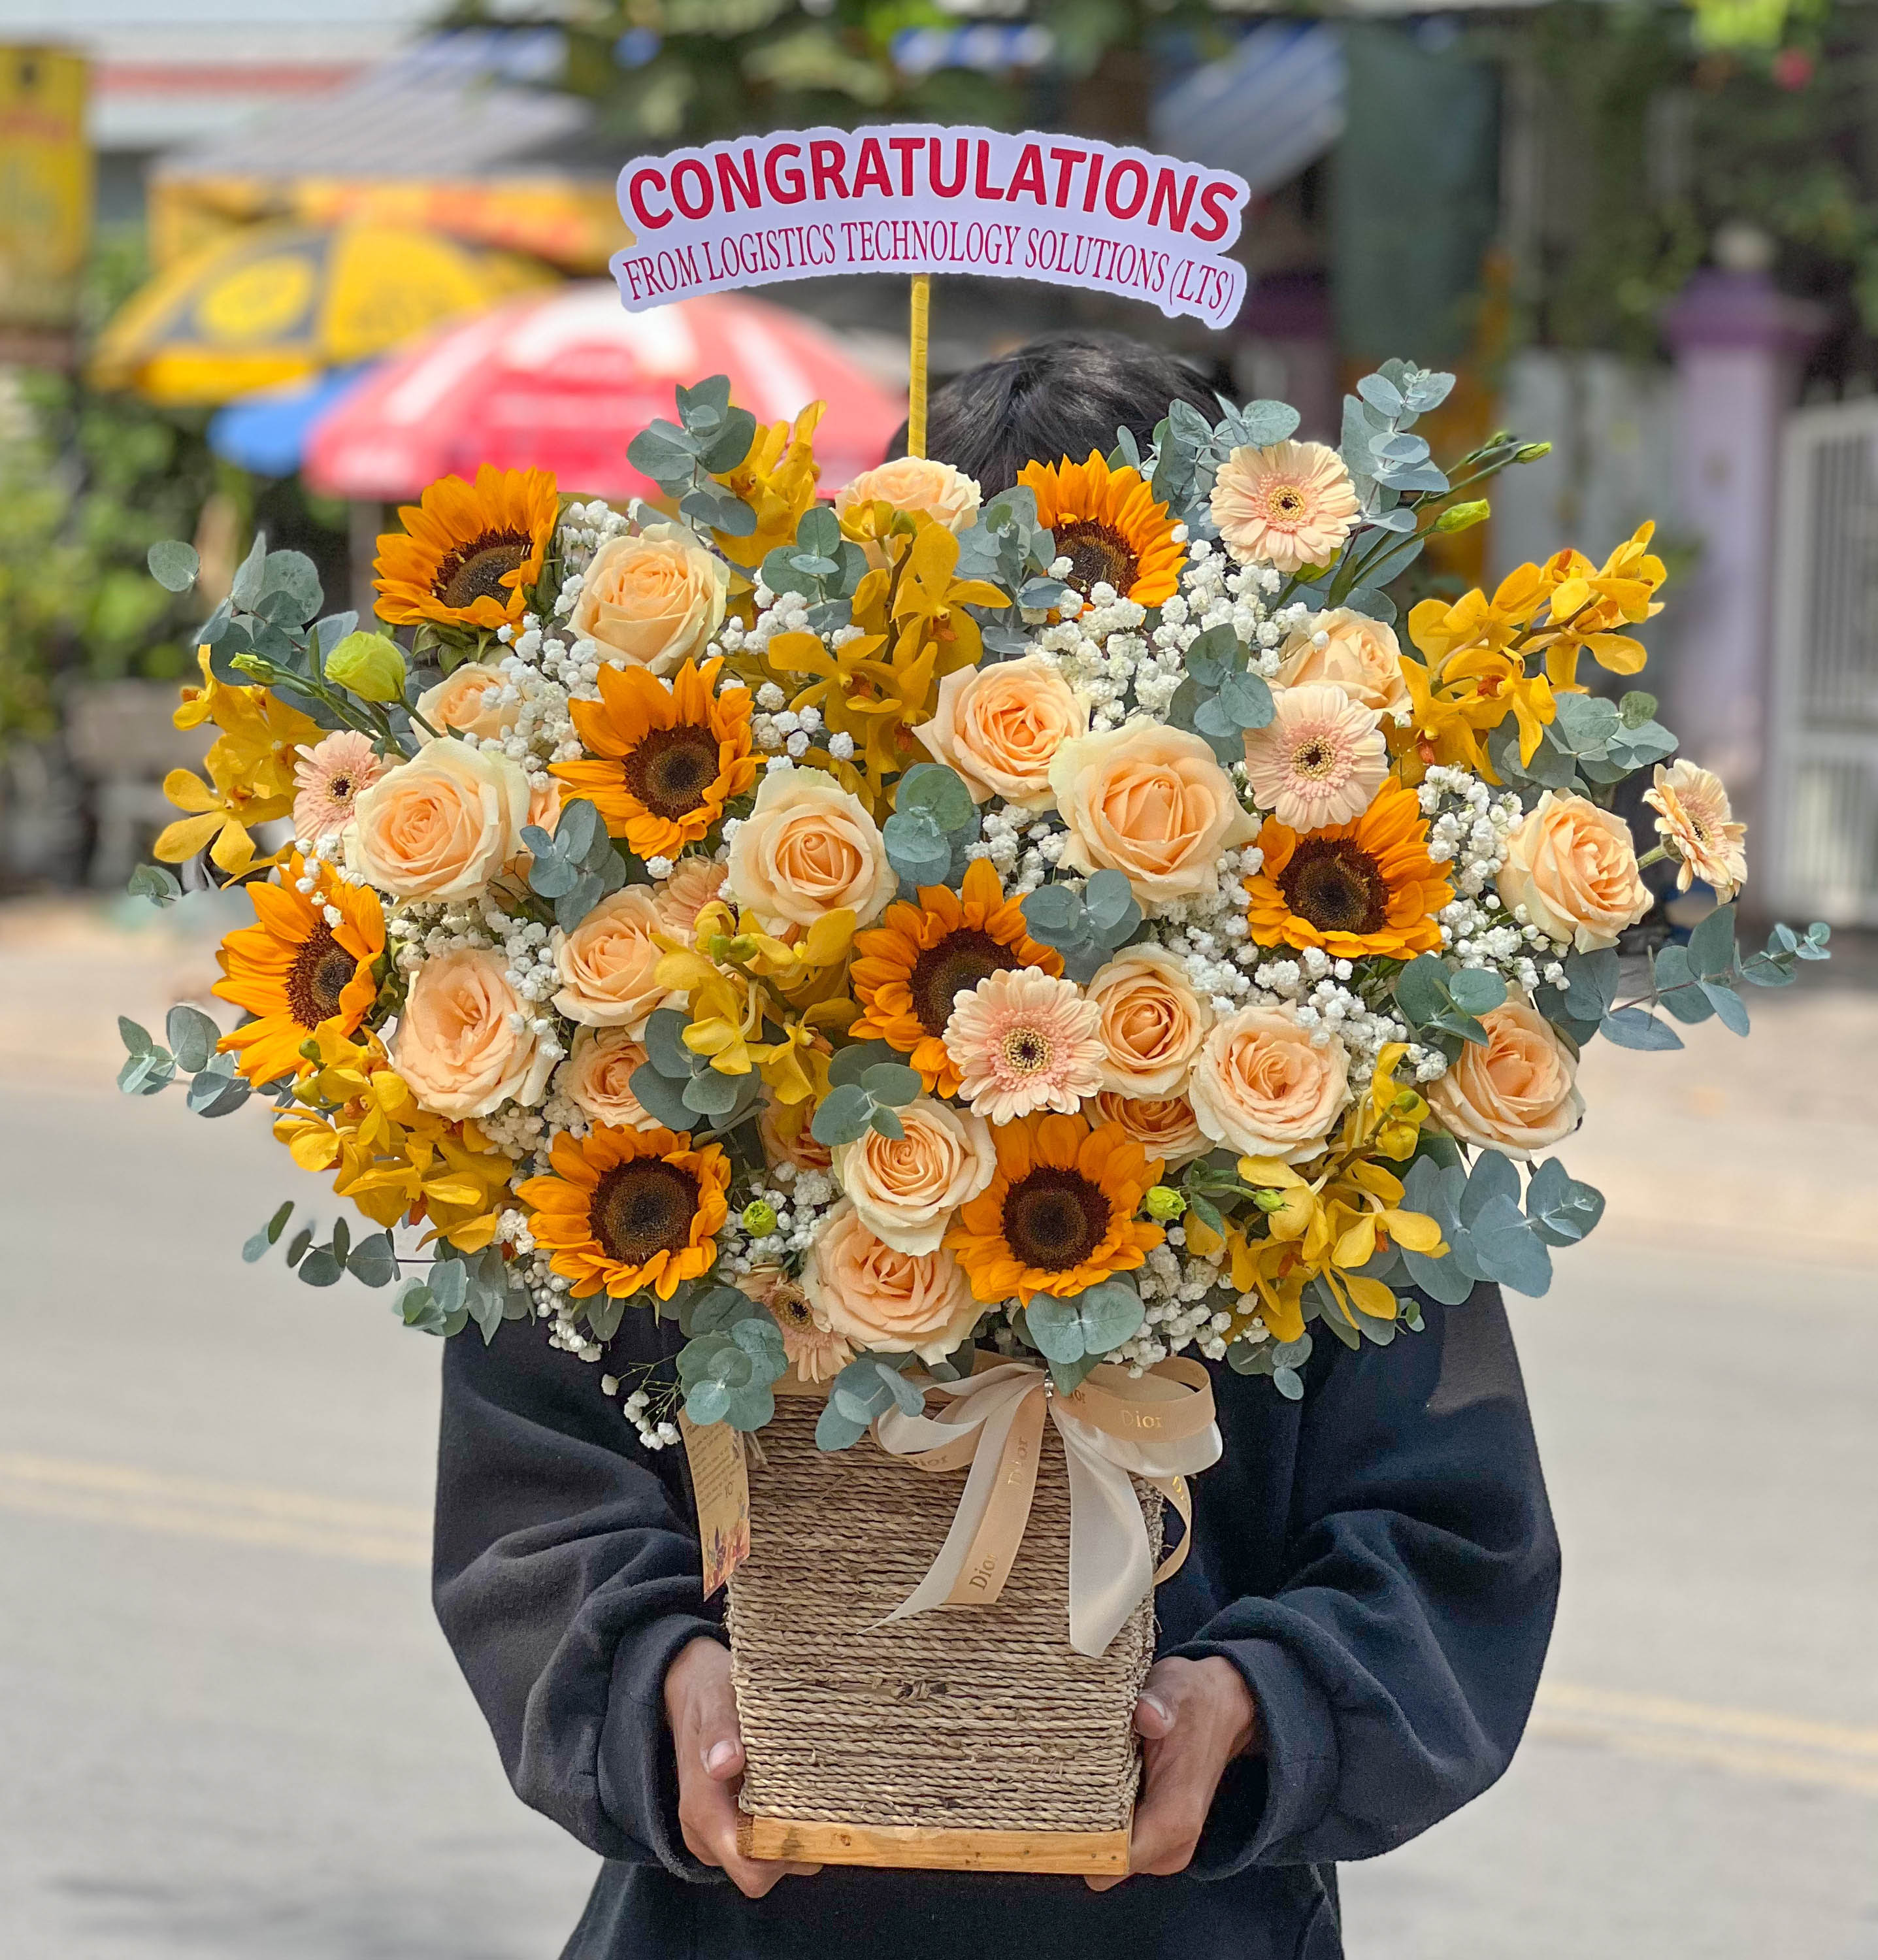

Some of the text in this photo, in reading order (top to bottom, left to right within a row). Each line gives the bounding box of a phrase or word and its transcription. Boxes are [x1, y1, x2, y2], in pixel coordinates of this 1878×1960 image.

[629, 137, 1238, 242] CONGRATULATIONS
[622, 220, 1236, 320] FROM LOGISTICS TECHNOLOGY SOLUTIONS (LTS)
[1122, 1410, 1164, 1429] Dior
[969, 1552, 998, 1591] Dior
